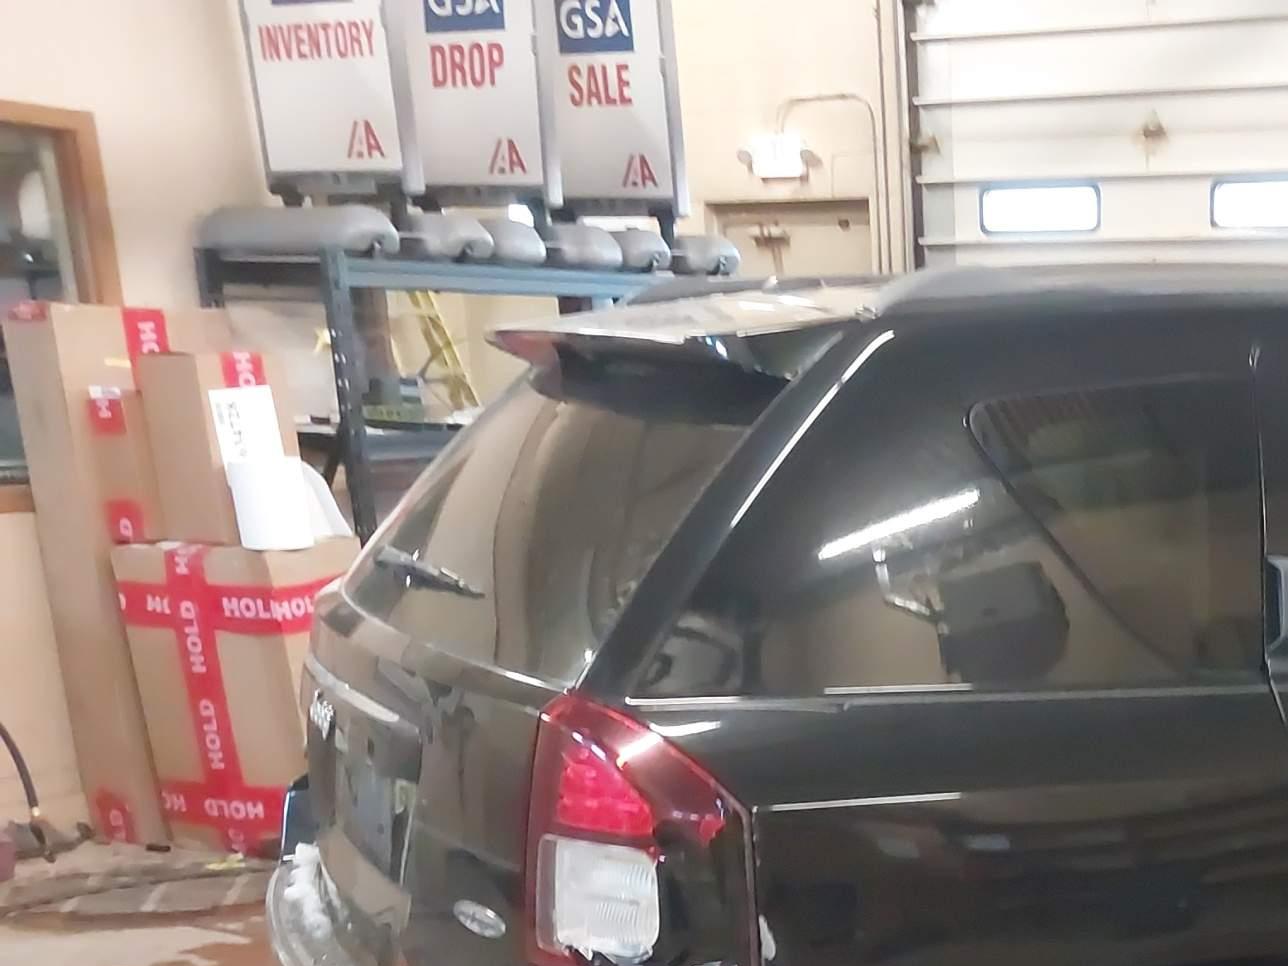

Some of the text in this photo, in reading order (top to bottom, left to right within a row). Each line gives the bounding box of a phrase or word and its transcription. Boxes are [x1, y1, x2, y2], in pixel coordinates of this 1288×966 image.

[258, 18, 374, 61] INVENTORY
[560, 0, 630, 38] GSA
[430, 42, 504, 88] DROP
[568, 64, 633, 107] SALE
[179, 600, 207, 674] HOLD
[200, 698, 226, 770] HOLD
[204, 798, 265, 820] HOLD
